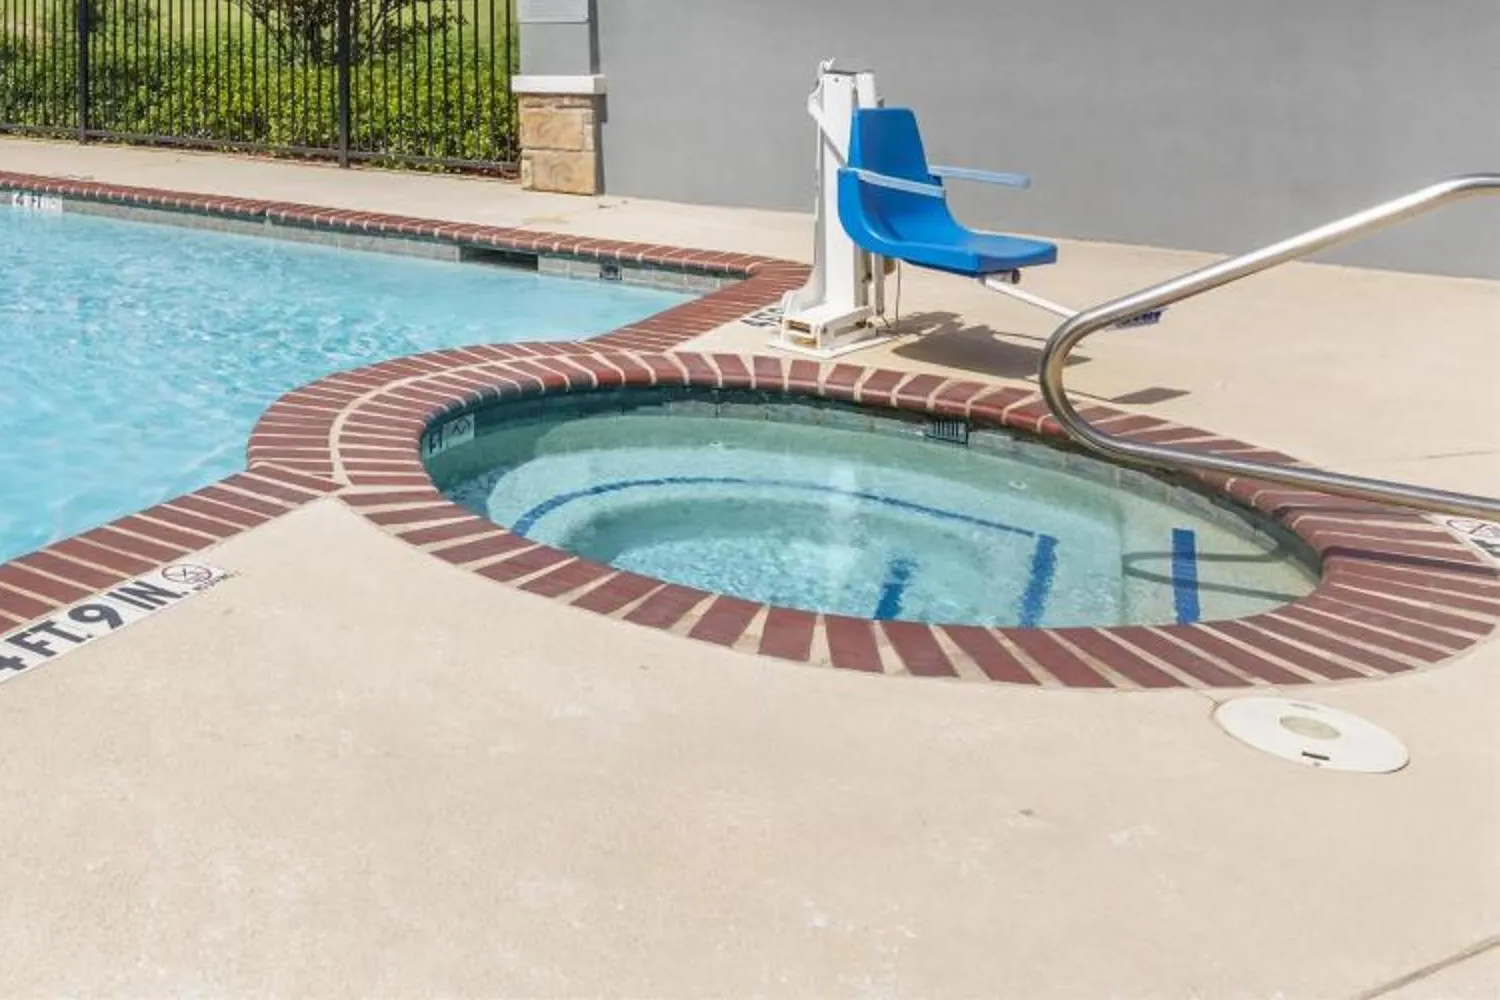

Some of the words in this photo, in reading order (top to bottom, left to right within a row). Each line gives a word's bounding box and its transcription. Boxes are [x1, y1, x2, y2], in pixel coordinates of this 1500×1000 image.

[4, 620, 93, 657] FT.
[67, 603, 124, 629] 9
[104, 581, 189, 611] IN.
